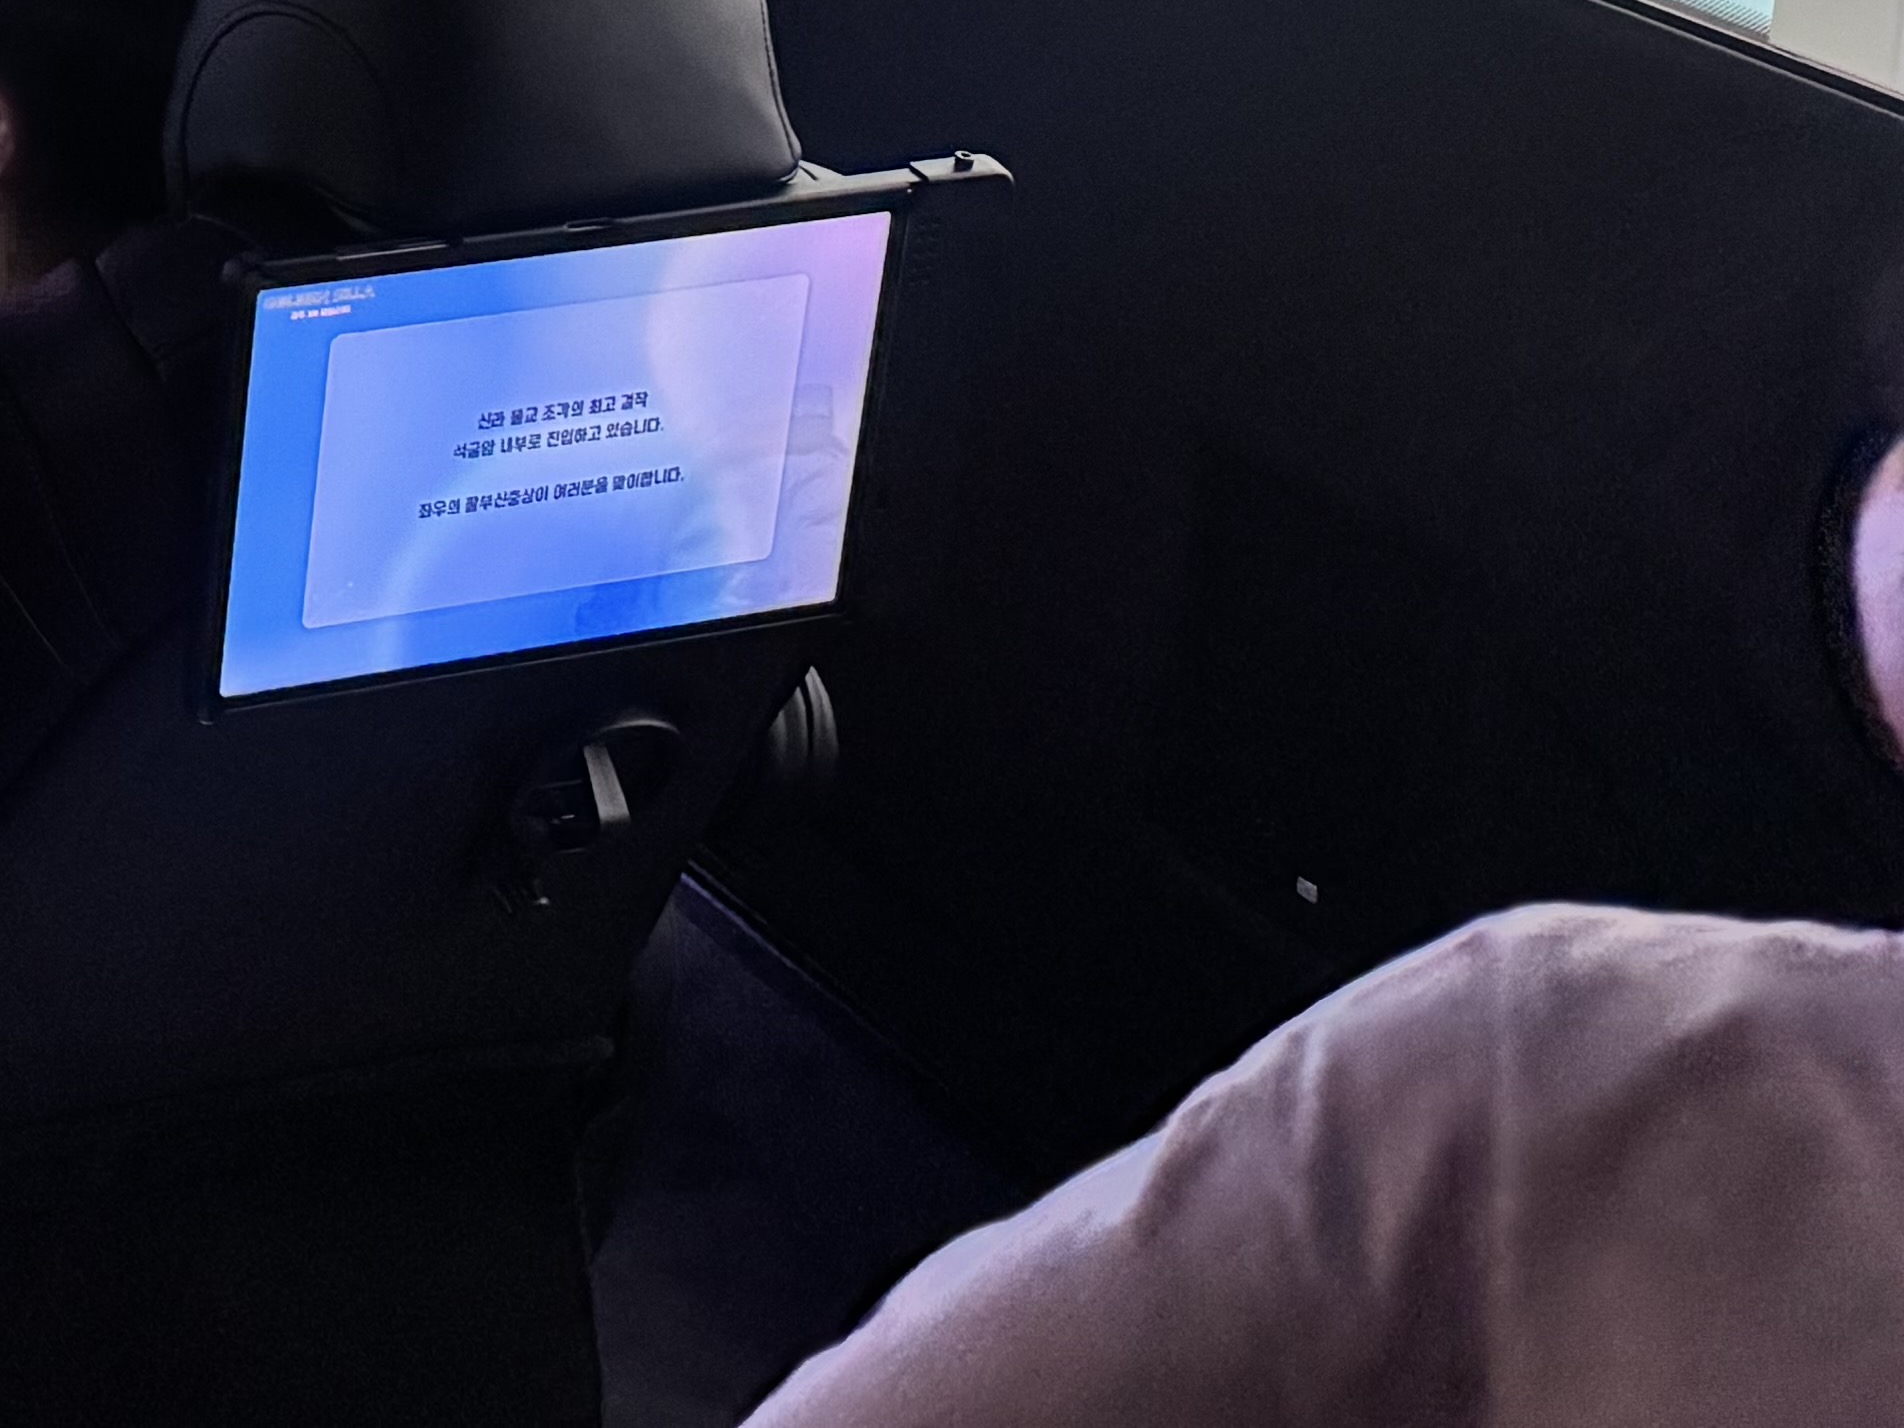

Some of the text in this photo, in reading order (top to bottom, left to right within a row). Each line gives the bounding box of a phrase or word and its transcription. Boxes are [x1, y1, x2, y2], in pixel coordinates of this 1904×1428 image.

[541, 400, 584, 422] 조각의
[589, 396, 616, 414] 최고
[621, 391, 648, 411] 걸작
[500, 433, 542, 453] 내부로
[546, 425, 601, 448] 진입하고
[605, 417, 664, 439] 있습니다.
[553, 476, 608, 500] 여러분을
